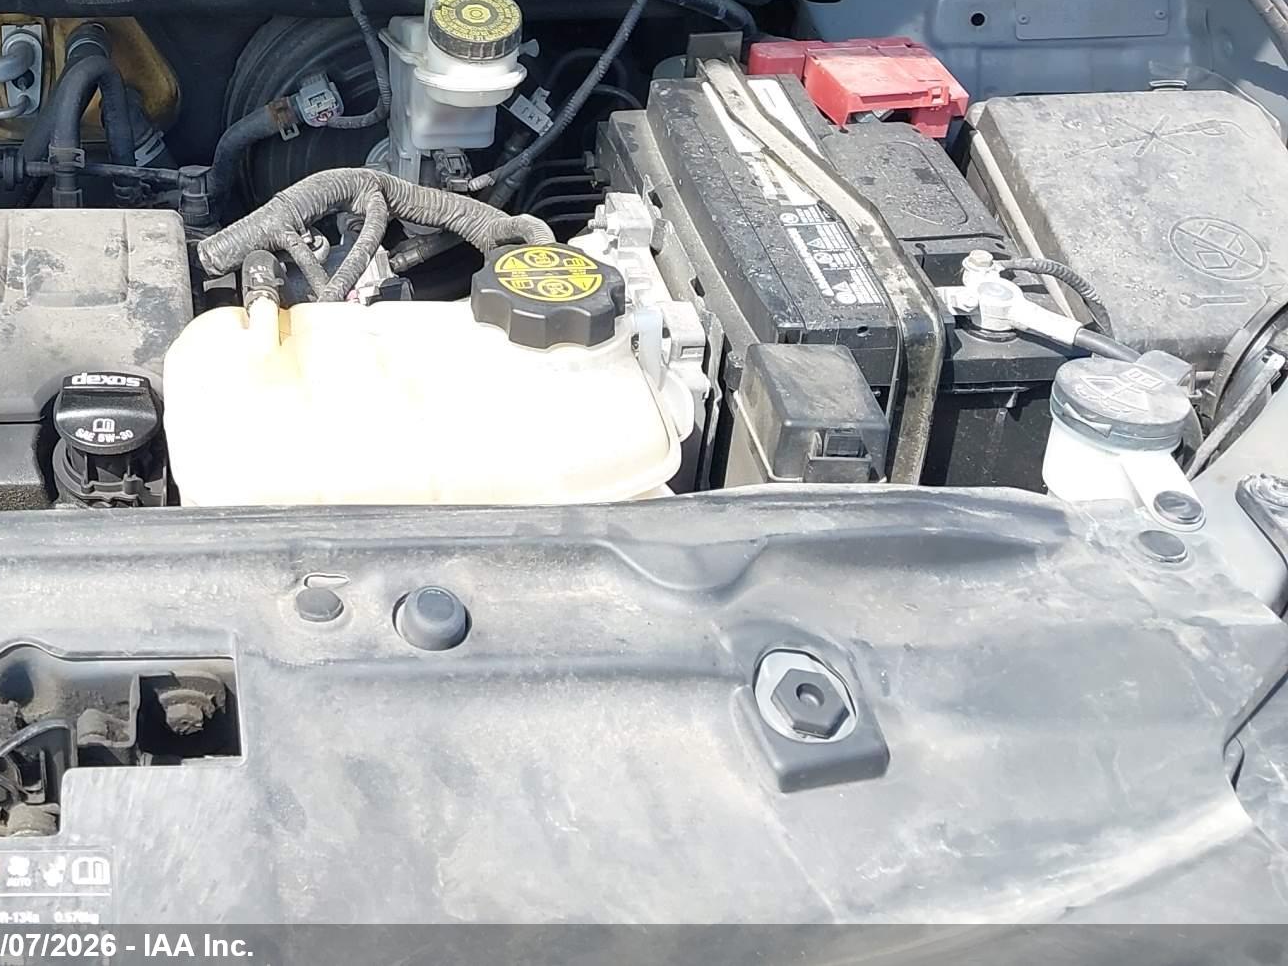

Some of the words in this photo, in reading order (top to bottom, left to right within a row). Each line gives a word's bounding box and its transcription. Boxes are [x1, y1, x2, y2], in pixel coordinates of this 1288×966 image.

[71, 372, 143, 387] dexos
[75, 427, 96, 442] SAE
[97, 429, 134, 442] 5W-30
[6, 876, 32, 887] AUTO
